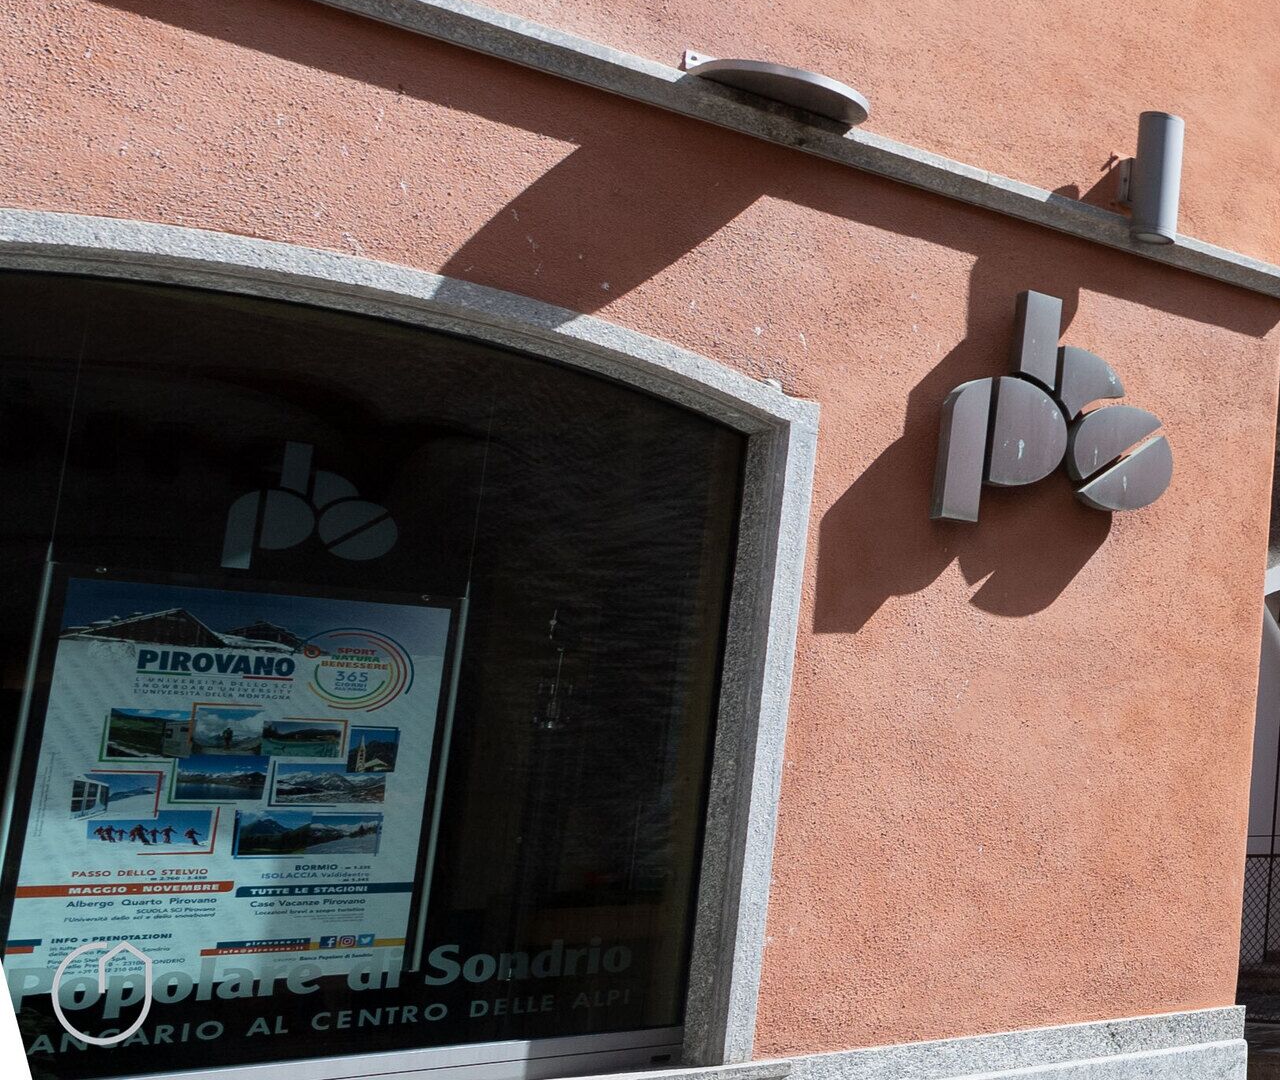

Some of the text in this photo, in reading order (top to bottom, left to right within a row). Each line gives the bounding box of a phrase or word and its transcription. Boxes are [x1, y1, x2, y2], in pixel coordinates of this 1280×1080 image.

[337, 647, 377, 656] SPORT
[137, 649, 296, 677] PIROVANO
[331, 654, 380, 663] NATURA
[321, 660, 389, 670] BENESSERE
[335, 670, 368, 683] 365
[134, 683, 292, 694] SNOWBOARD UNIVERSITY
[238, 693, 291, 701] MONTAGNA
[71, 868, 208, 878] PASSO DELLO STELVIO
[261, 872, 318, 880] ISOLACCIA
[68, 886, 127, 894] MAGGIO
[142, 883, 220, 892] NOVEMBRE
[313, 885, 368, 893] STAGIONI
[66, 897, 217, 909] Albergo Quarto Pirovano
[92, 933, 172, 942] PRENOTAZIONI
[8, 937, 632, 1019] Popolare di Sondrio
[26, 987, 631, 1056] ANCARIO AL CENTRO DELLE ALPI
